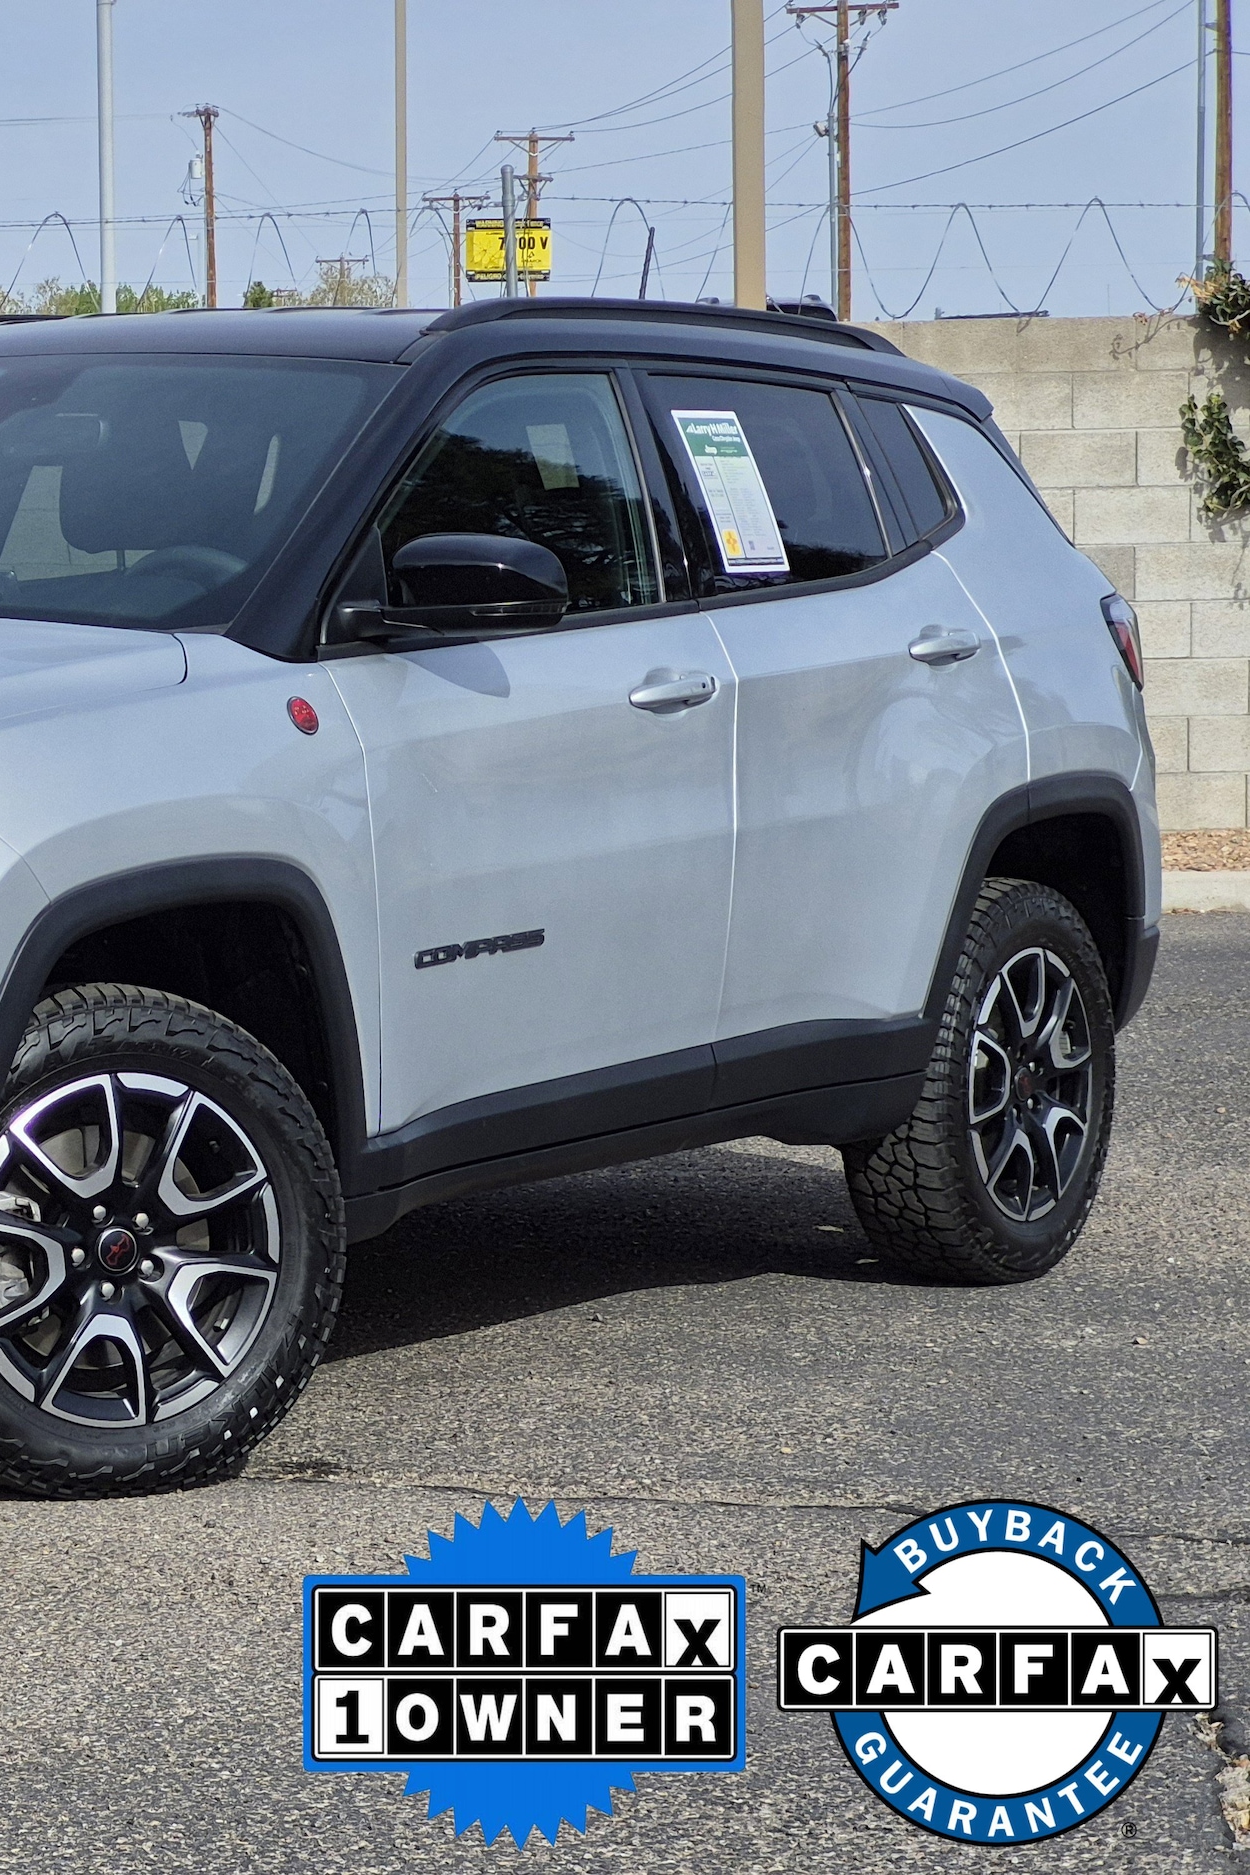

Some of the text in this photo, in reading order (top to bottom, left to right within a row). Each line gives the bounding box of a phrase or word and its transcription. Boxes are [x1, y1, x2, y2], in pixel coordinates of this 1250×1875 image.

[498, 236, 548, 250] 700 V
[414, 928, 545, 969] COMPASS
